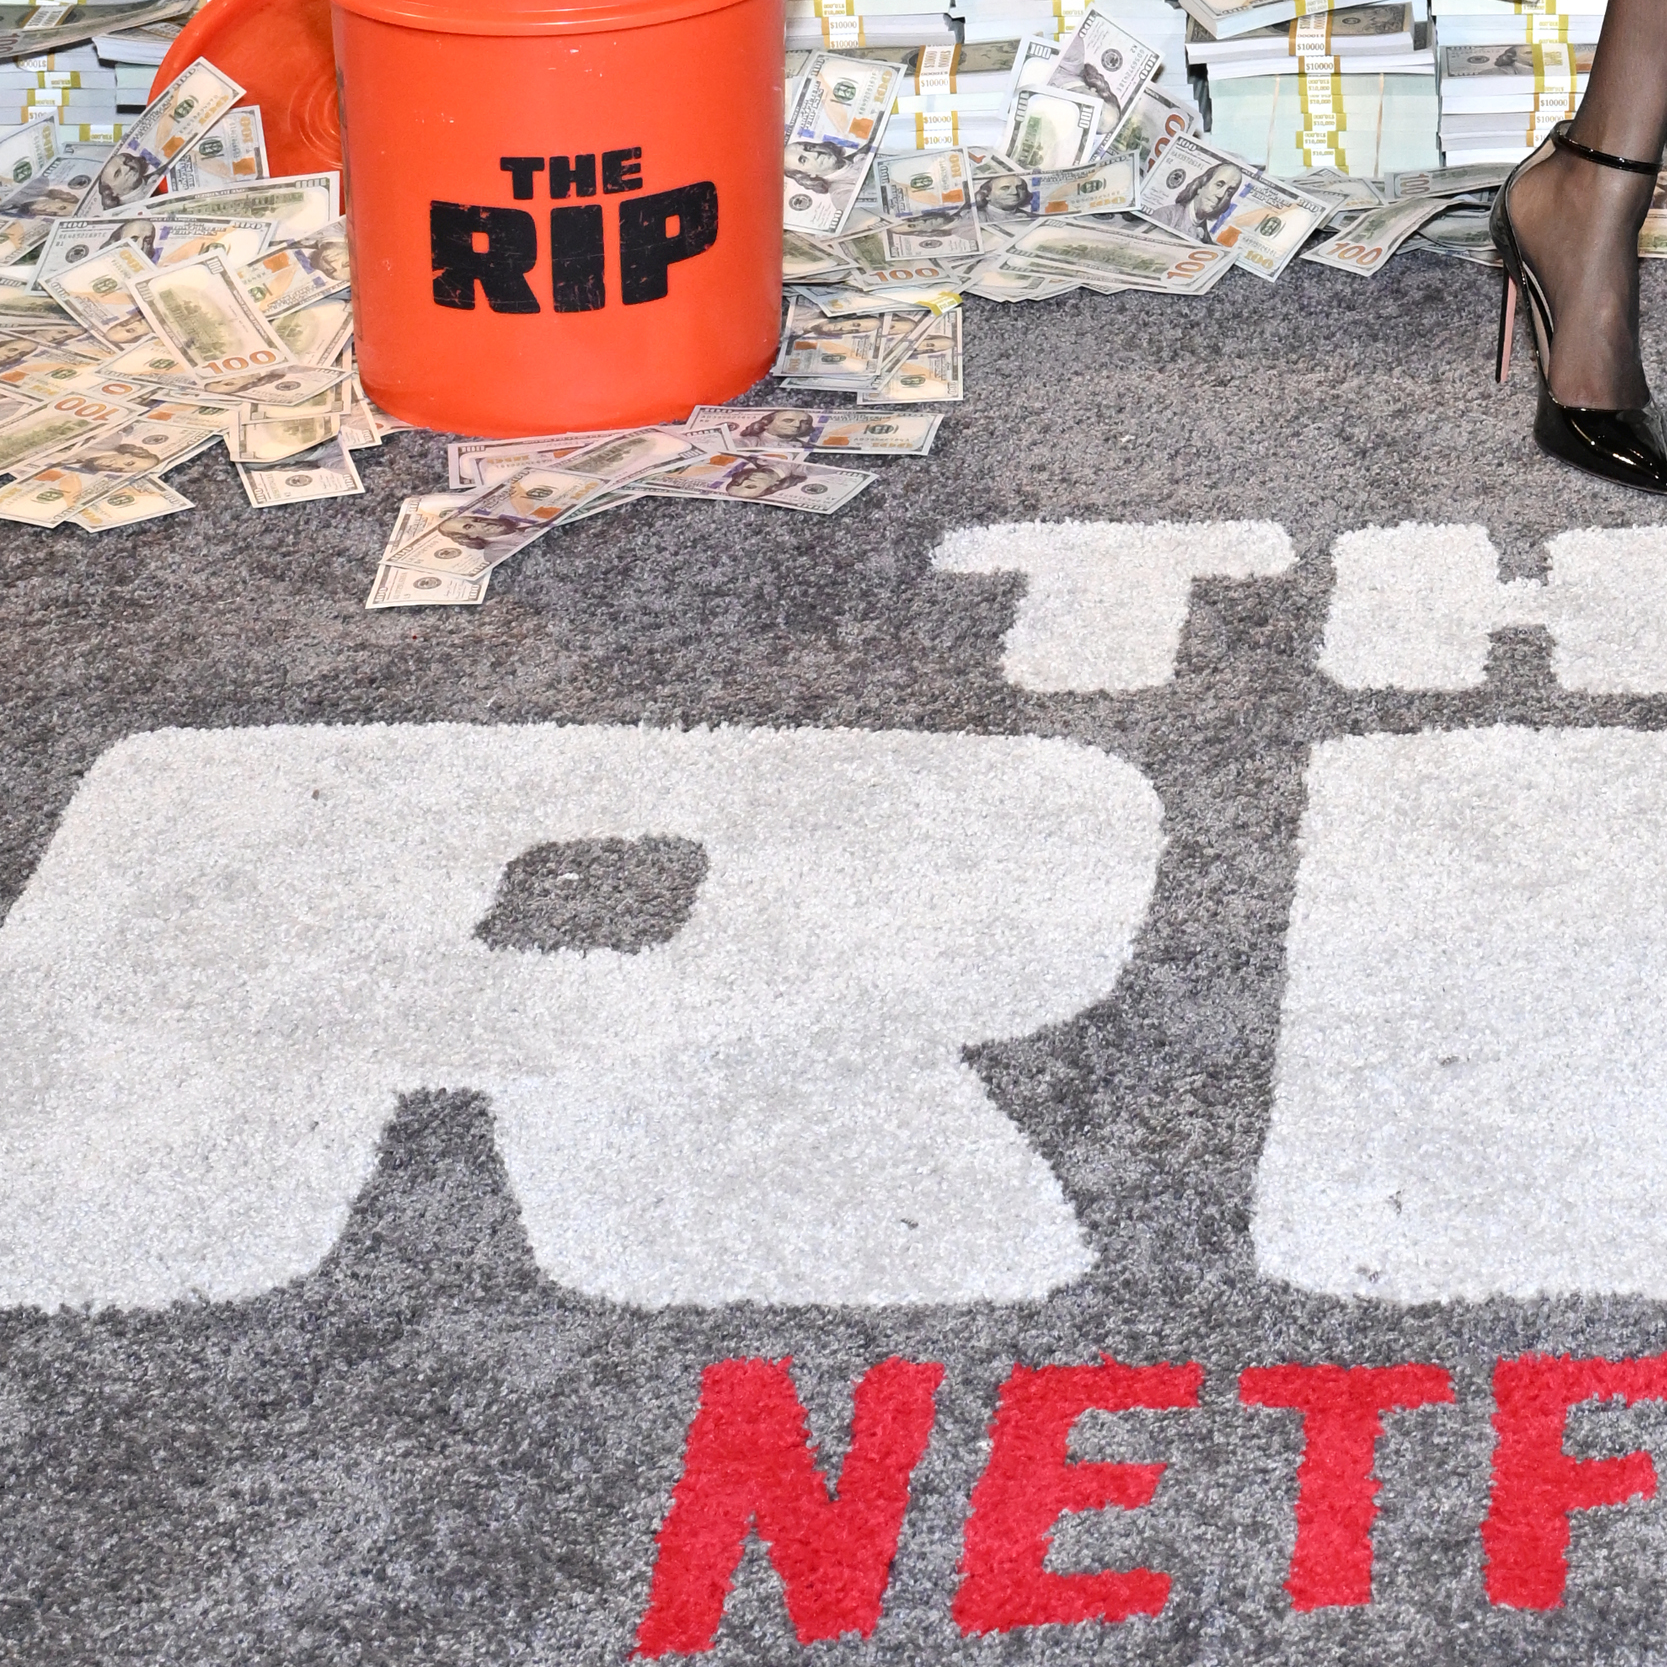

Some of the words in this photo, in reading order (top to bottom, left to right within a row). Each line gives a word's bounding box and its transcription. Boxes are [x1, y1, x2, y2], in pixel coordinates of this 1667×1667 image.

[500, 146, 643, 200] THE
[430, 181, 719, 314] RIP
[1326, 242, 1383, 267] 100
[869, 268, 940, 282] 100
[1166, 250, 1218, 280] 100
[201, 350, 277, 375] 100
[54, 397, 119, 422] 100
